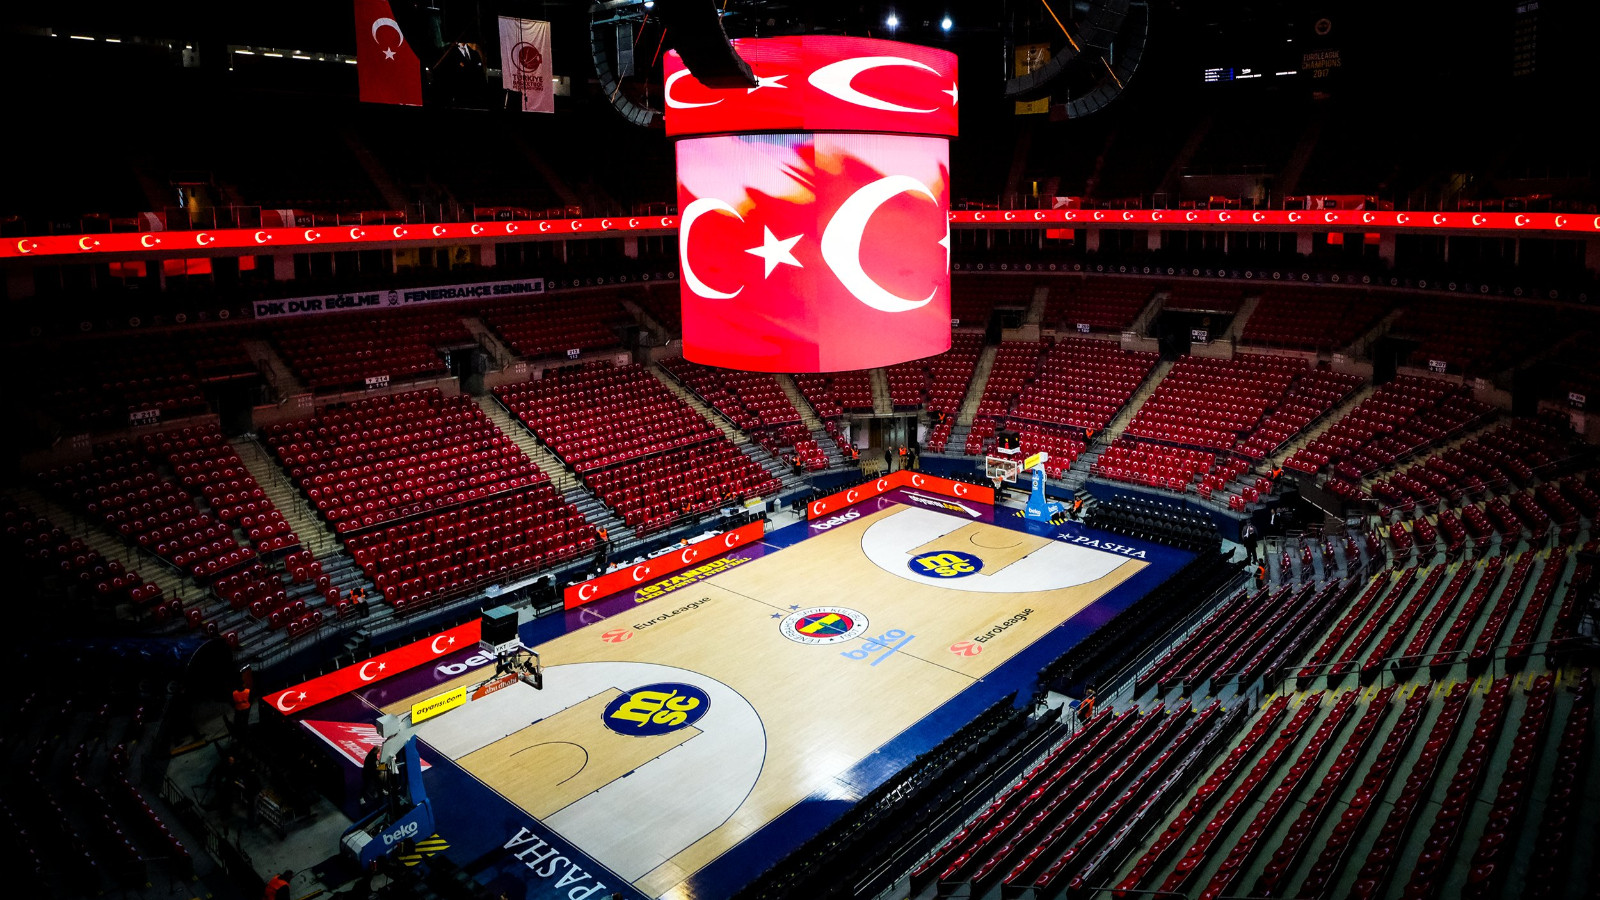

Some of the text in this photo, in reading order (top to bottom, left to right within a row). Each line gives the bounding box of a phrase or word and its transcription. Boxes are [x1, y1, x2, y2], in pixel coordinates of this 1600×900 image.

[1302, 58, 1342, 69] CHAMPIONS
[1303, 51, 1340, 61] EUROLEAGUE
[1313, 69, 1329, 78] 2017
[404, 285, 492, 302] FENERBAHÇE
[288, 300, 322, 312] DUR
[810, 510, 861, 532] beko
[1071, 535, 1147, 559] PASHA
[633, 597, 712, 630] EuroLeague
[974, 607, 1035, 644] EuroLeague
[840, 628, 907, 661] beko
[382, 821, 419, 846] beko
[503, 826, 607, 900] PASHA
